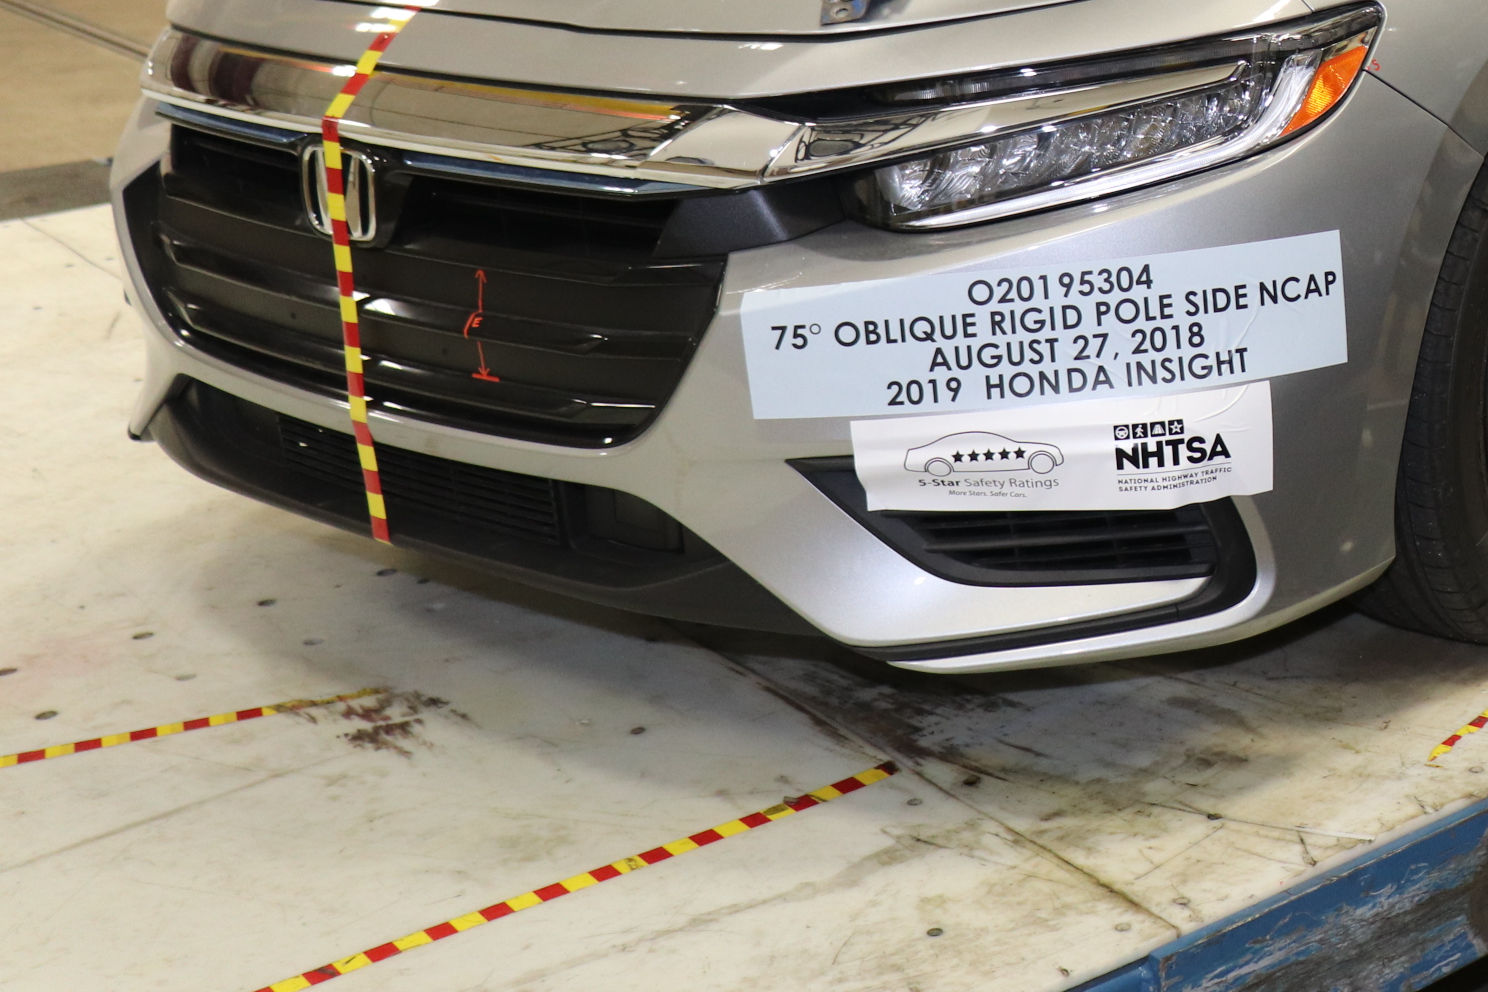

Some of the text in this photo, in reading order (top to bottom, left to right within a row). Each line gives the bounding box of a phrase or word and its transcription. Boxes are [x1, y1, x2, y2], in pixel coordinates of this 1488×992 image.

[770, 271, 1337, 351] 75° OBLIQUE RIGID POLE SIDE NCAP
[929, 322, 1205, 373] AUGUST 27, 2018
[886, 347, 1249, 407] 2019 HONDA INSIGHT
[1115, 433, 1232, 471] NHTSA
[918, 478, 1060, 490] 5-Star Safety Ratings
[1150, 475, 1218, 491] ADMINISTRATION
[1162, 472, 1200, 483] HIGHWAY
[1201, 466, 1233, 476] TRAFFIC
[948, 489, 968, 497] More
